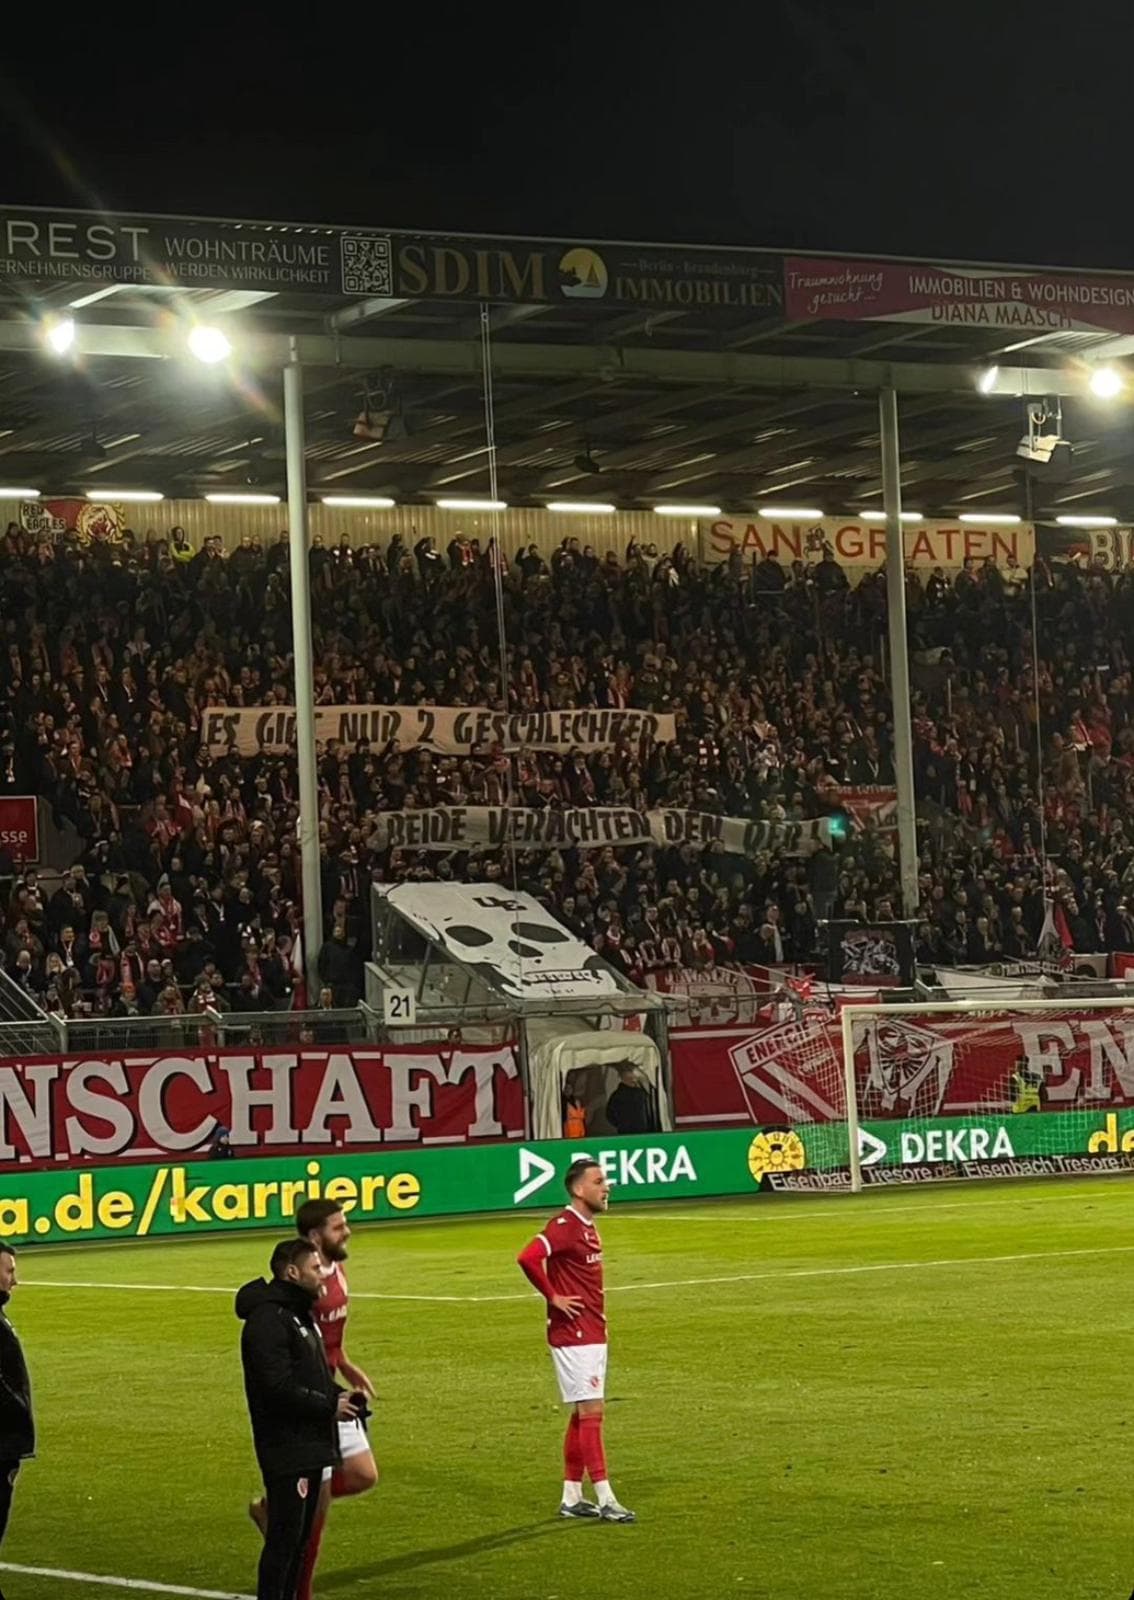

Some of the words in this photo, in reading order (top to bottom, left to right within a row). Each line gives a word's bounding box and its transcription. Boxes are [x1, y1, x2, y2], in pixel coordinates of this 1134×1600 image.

[7, 220, 149, 261] REST
[165, 237, 329, 266] WOHNTRÄUME
[165, 261, 229, 280] WERDEN
[232, 265, 330, 284] WIRKLICHKEIT
[400, 245, 547, 298] SDIM
[616, 276, 784, 307] IMMOBILIEN
[909, 276, 1006, 299] IMMOBILIEN
[1011, 281, 1023, 299] &
[1028, 282, 1134, 306] WOHNDESIGN
[931, 302, 989, 323] DIANA
[995, 304, 1073, 329] MAASCH
[836, 526, 1018, 563] GRATEN
[207, 712, 241, 745] ES
[339, 710, 402, 745] NUR
[417, 709, 435, 744] 2
[387, 808, 467, 846] BEIDE
[487, 807, 651, 844] VERACHTEN
[663, 811, 724, 841] DEN
[390, 994, 410, 1018] 21
[0, 1046, 518, 1161] NSCHAFT
[901, 1127, 1016, 1164] DEKRA
[571, 1145, 697, 1185] EKRA
[768, 1170, 852, 1192] Eisenbac
[963, 1154, 1055, 1179] Eisenbach
[0, 1161, 420, 1236] a.de/karriere
